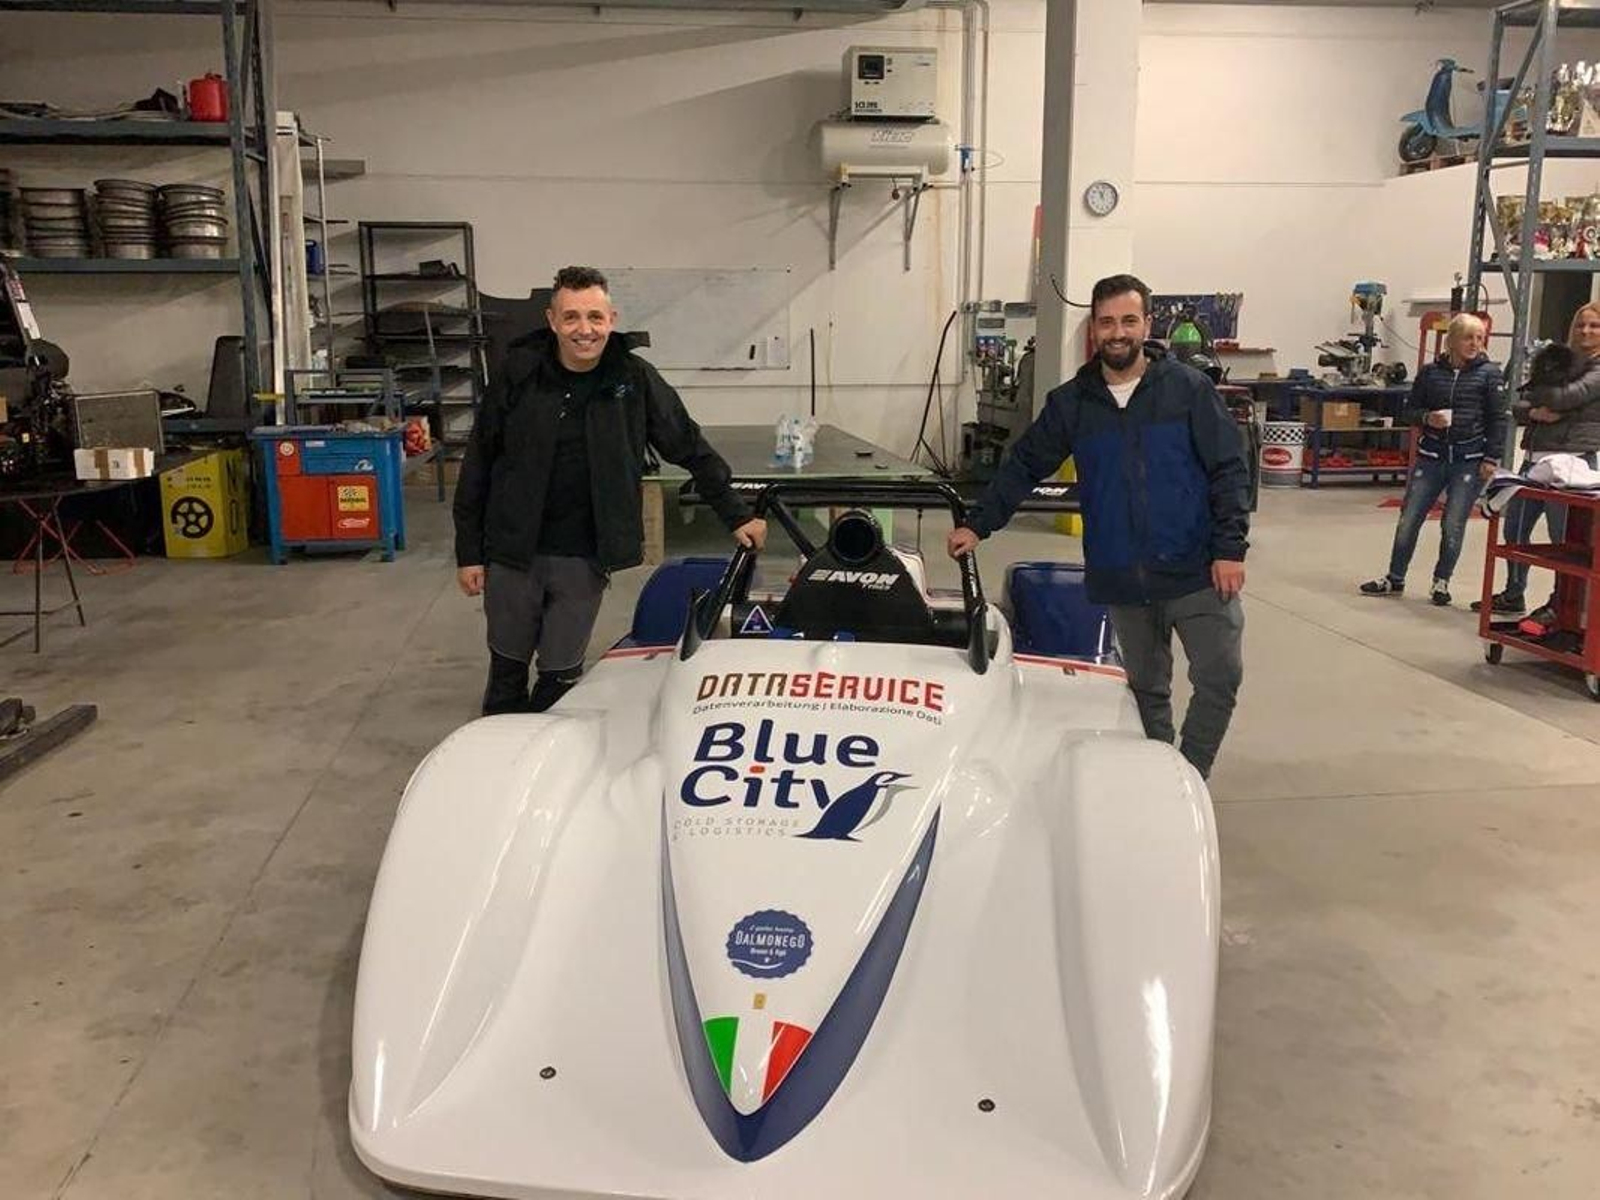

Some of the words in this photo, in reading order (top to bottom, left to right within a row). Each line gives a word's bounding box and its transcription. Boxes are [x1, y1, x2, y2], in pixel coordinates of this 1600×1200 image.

[826, 569, 900, 587] AVON
[696, 672, 944, 711] DATASERVICE
[693, 700, 822, 714] Datenverarbeitung
[829, 702, 914, 717] Elaborazione
[915, 709, 943, 725] Dati
[693, 719, 880, 767] Blue
[673, 815, 716, 830] COLD
[688, 826, 787, 837] LOGISTICS
